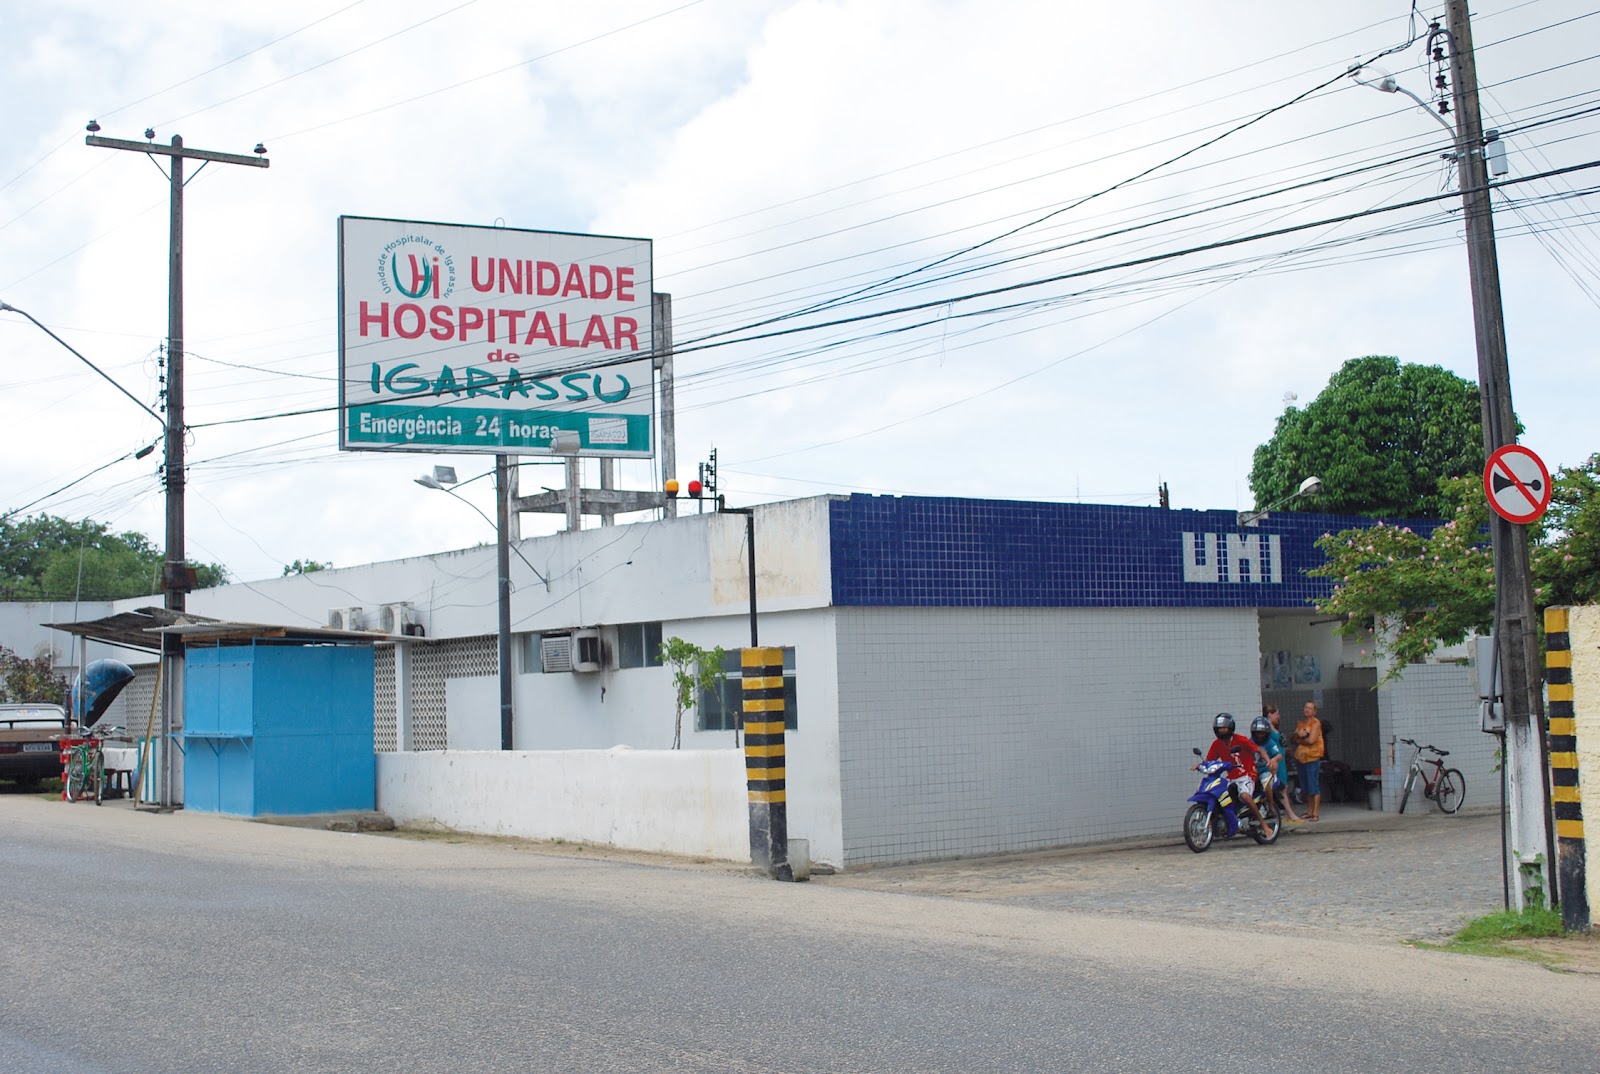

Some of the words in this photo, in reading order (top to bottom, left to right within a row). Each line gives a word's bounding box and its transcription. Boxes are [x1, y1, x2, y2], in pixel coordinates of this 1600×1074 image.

[384, 235, 434, 253] Hospitalar
[434, 245, 446, 255] de
[377, 253, 392, 294] Unidade
[443, 255, 456, 299] Igarassu
[470, 256, 635, 301] UNIDADE
[359, 301, 639, 351] HOSPITALAR
[487, 349, 520, 363] de
[371, 362, 631, 403] IGARASSU
[360, 412, 462, 440] Emergência
[475, 415, 500, 437] 24
[509, 420, 560, 439] horas
[1182, 531, 1283, 583] UMI
